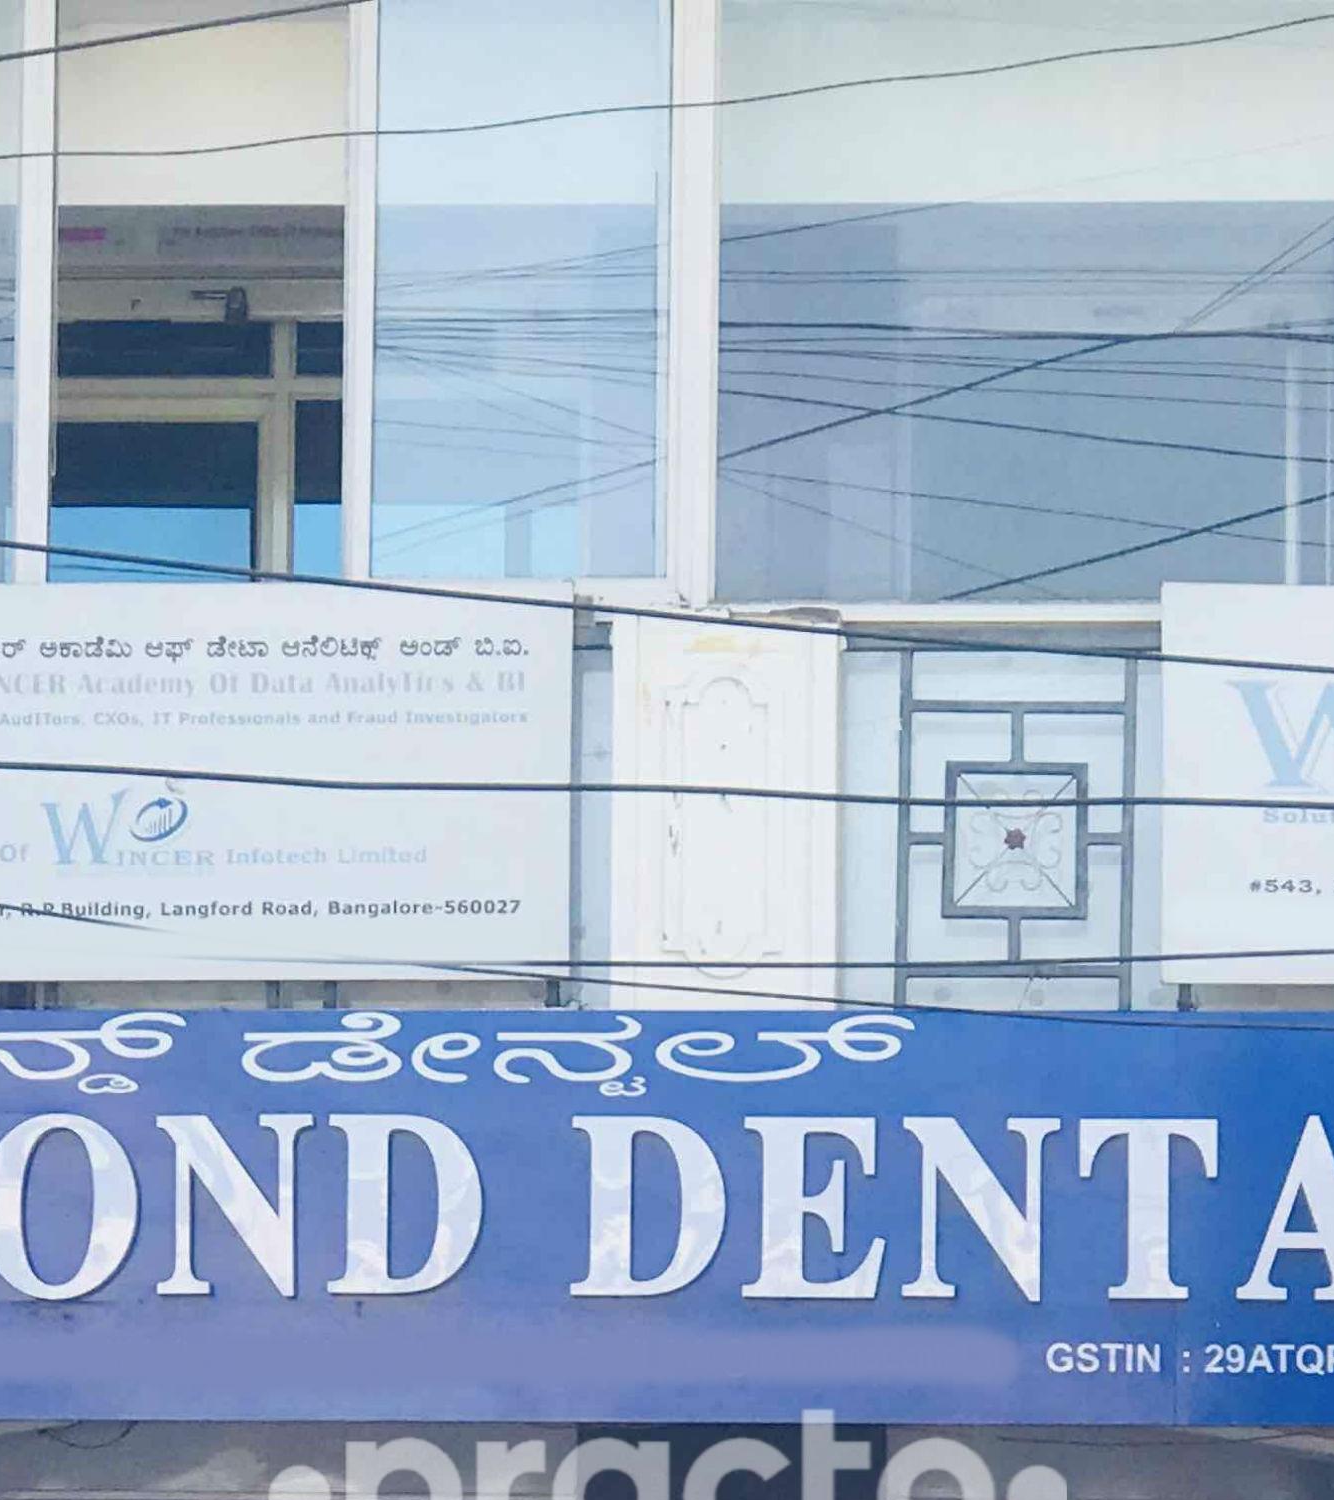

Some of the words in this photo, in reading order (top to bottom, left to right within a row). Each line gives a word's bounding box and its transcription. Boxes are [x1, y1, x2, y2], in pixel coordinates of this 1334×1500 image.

[77, 673, 196, 698] Academy
[251, 672, 314, 694] Data
[0, 843, 31, 863] Of
[41, 788, 215, 867] WINCER
[226, 847, 328, 865] Infotech
[337, 846, 428, 864] Limited
[1249, 879, 1323, 896] #543,
[160, 902, 253, 919] Langford
[261, 902, 319, 918] Road,
[328, 899, 522, 916] Bangalore-560027
[1046, 1342, 1161, 1374] GSTIN
